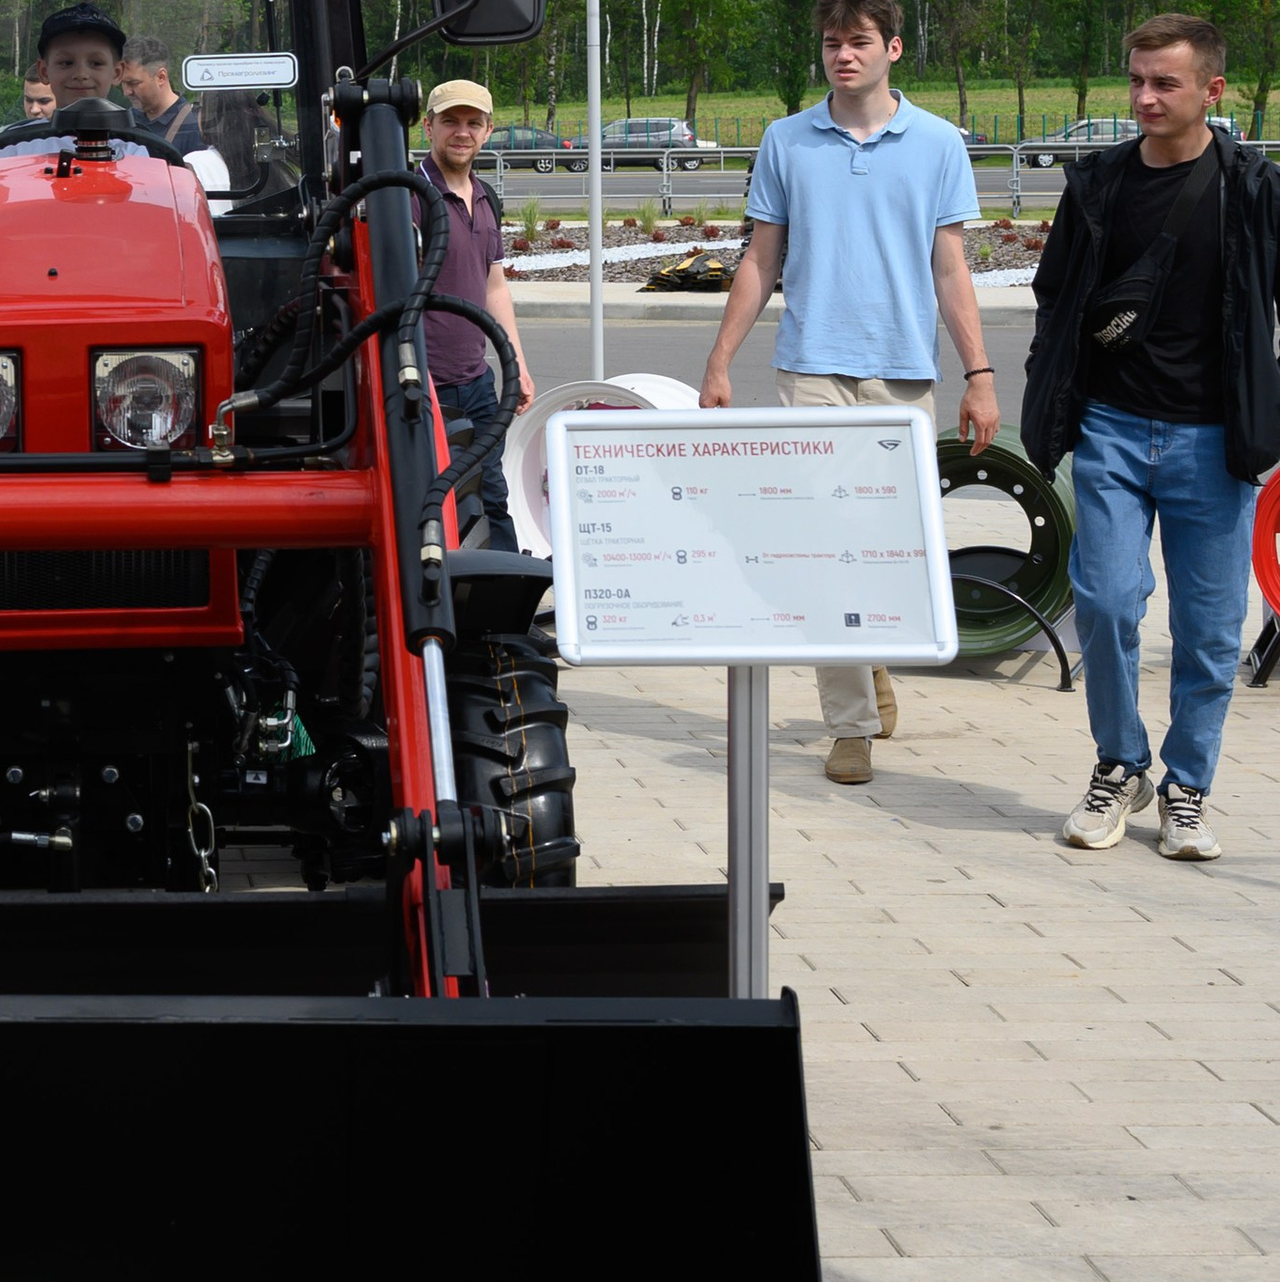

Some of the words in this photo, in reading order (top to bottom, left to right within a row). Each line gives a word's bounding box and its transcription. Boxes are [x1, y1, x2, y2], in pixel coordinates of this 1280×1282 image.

[573, 443, 687, 459] ТЕХНИЧЕСКИЕ
[692, 440, 834, 457] ХАРАКТЕРИСТИКИ
[575, 465, 605, 475] ОТ-18
[598, 475, 641, 483] ТРАКТОРНЫЙ
[597, 490, 617, 498] 2000
[759, 487, 778, 495] 1800
[854, 486, 873, 494] 1800
[881, 486, 897, 494] 590
[579, 523, 612, 534] ЩТ-15
[604, 537, 645, 545] ТРАКТОРНАЯ
[691, 550, 706, 558] 295
[861, 550, 878, 558] 1710
[602, 615, 617, 623] 320
[693, 614, 705, 623] 0,3
[773, 613, 791, 621] 1700
[867, 614, 887, 622] 2700
